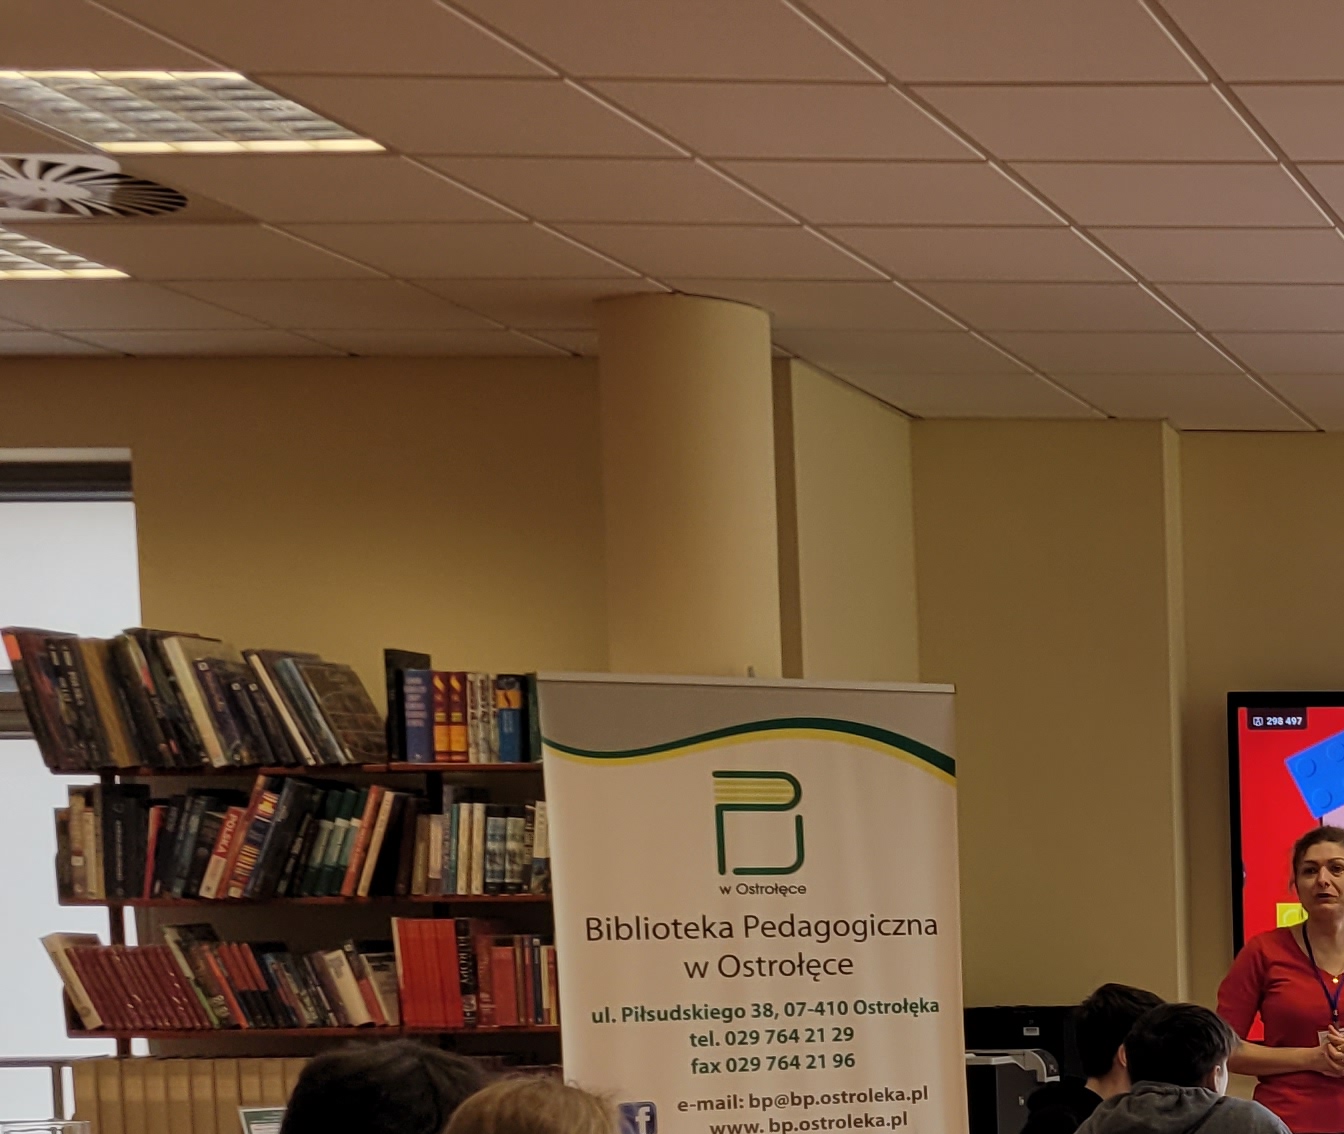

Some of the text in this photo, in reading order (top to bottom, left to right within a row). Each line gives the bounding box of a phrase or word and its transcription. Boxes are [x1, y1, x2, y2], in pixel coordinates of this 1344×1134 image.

[1285, 716, 1303, 726] 497
[719, 882, 807, 897] w Ostrołęce
[585, 913, 938, 944] Biblioteka Pedagogiczna
[684, 952, 854, 982] w Ostrołęce
[591, 997, 940, 1024] ul. Piłsudskiego 38, 07-410 Ostrołęka
[689, 1026, 855, 1048] tel. 029 764 21 29
[690, 1052, 856, 1075] fax 029 764 21 96
[677, 1085, 929, 1112] e-mail: bp@bp.ostroleka.pl
